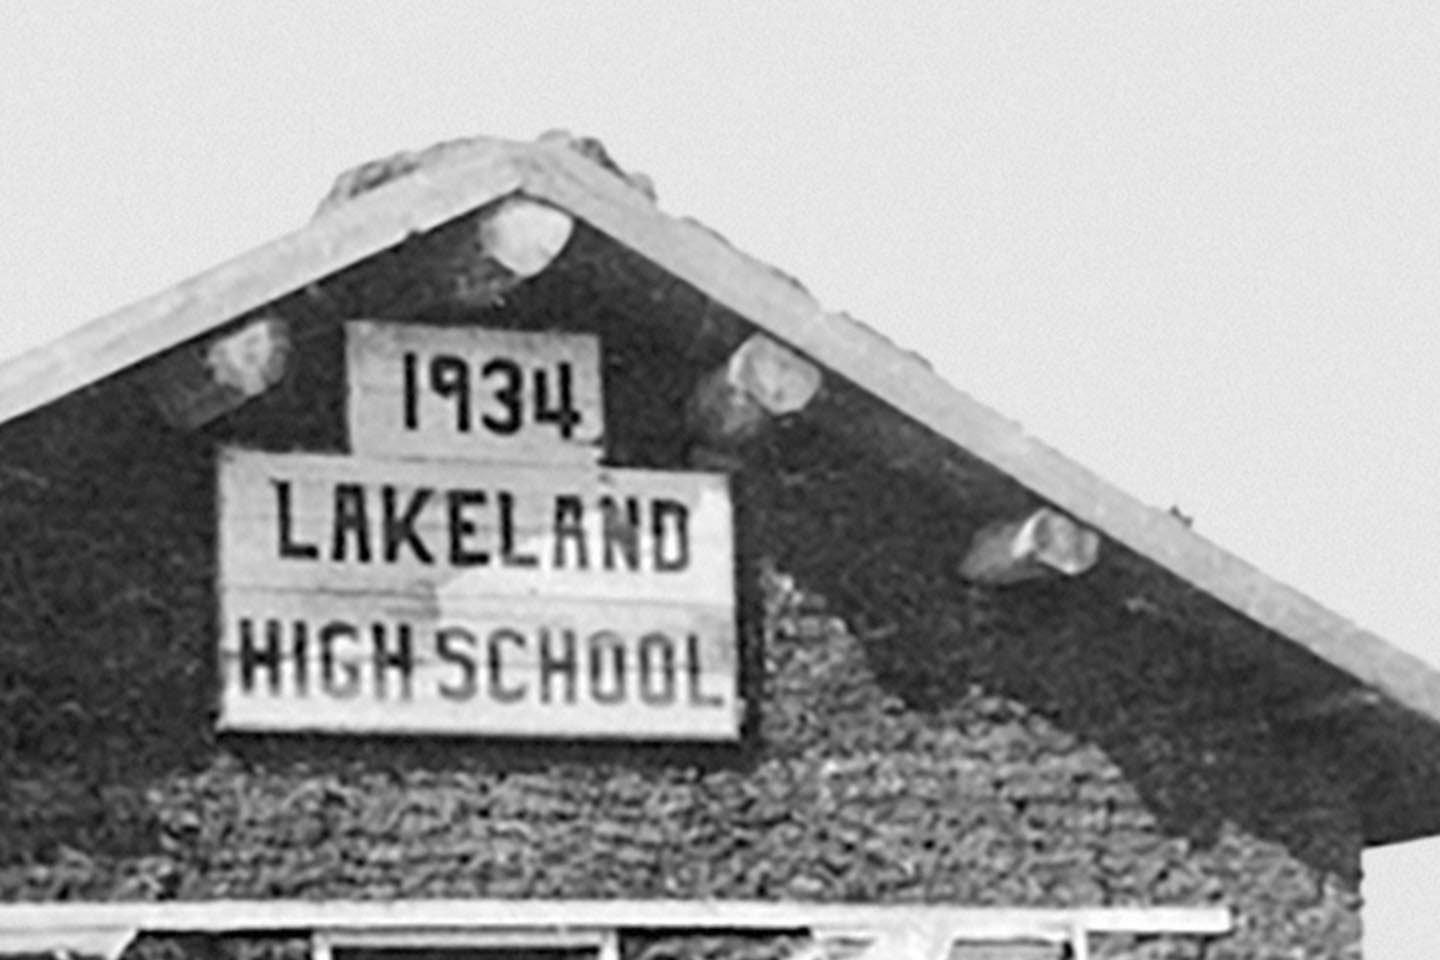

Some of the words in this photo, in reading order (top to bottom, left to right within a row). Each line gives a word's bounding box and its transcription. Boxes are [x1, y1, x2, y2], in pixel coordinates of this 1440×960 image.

[402, 351, 583, 440] 1934
[270, 477, 690, 572] LAKELAND
[238, 617, 414, 701] HIGH
[435, 626, 726, 708] SCHOOL
